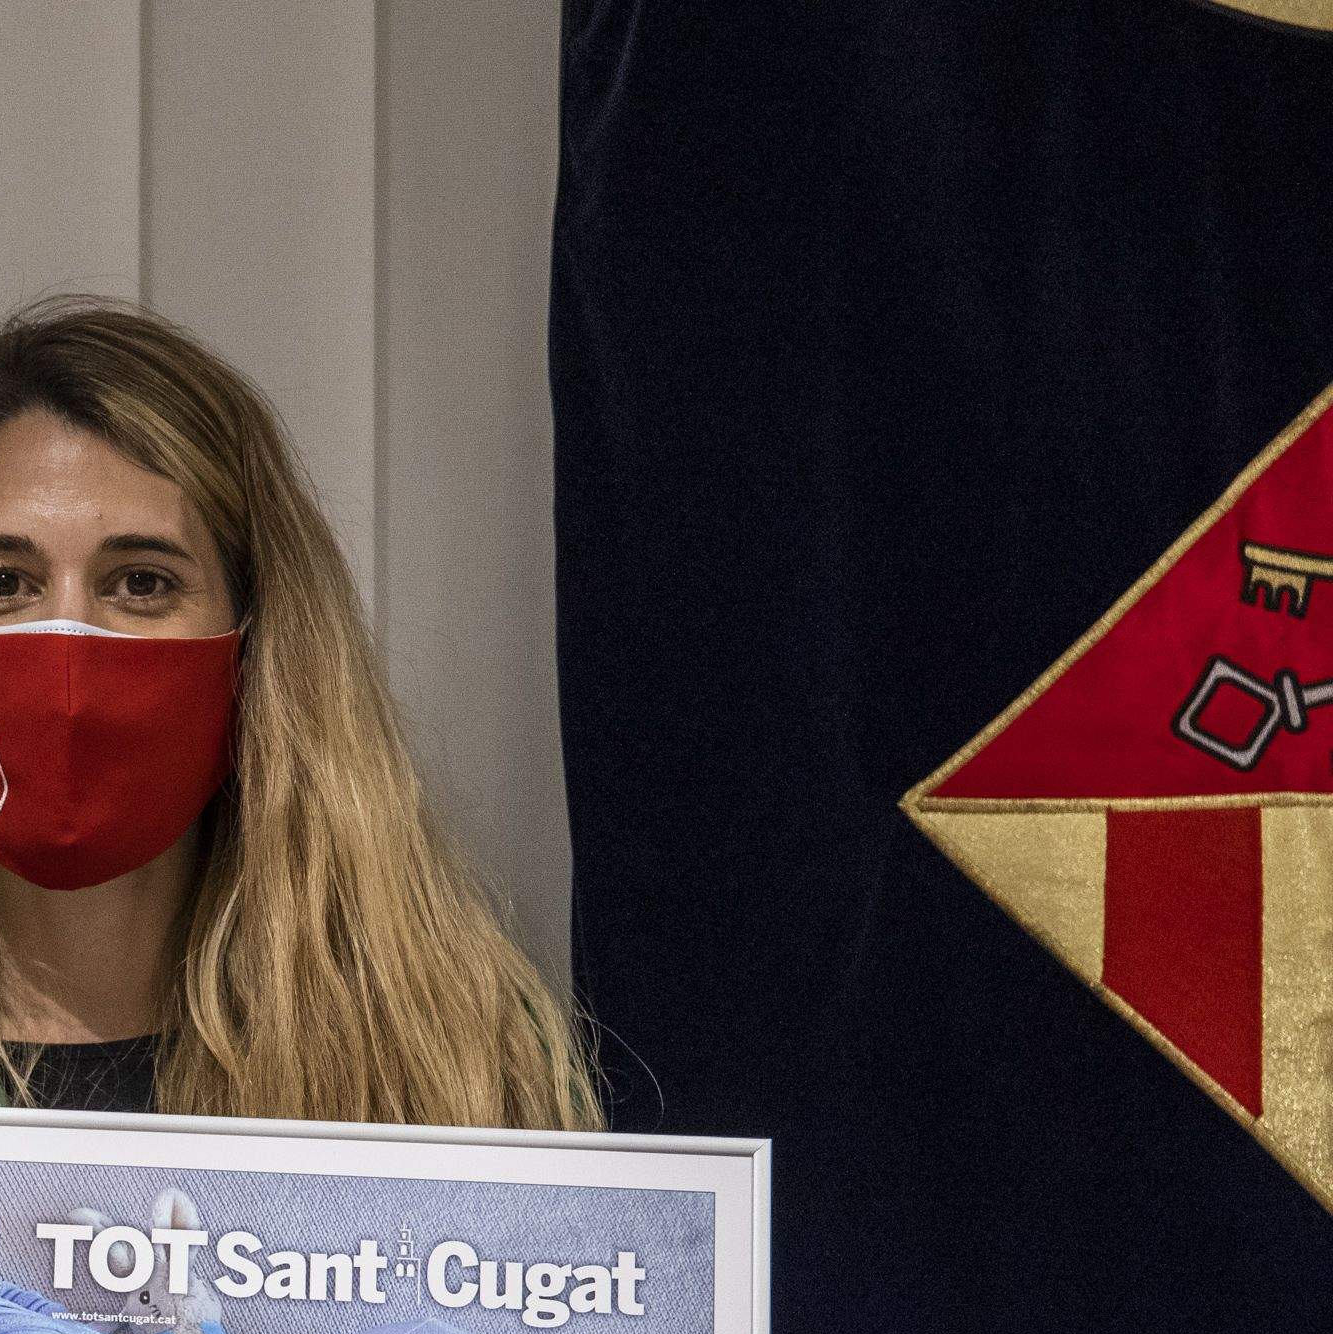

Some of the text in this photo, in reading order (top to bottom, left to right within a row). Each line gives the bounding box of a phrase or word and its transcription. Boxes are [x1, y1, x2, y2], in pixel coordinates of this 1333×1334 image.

[36, 1222, 646, 1328] TOT Sant Cugat
[52, 1312, 176, 1325] www.totsantcugat.cat
